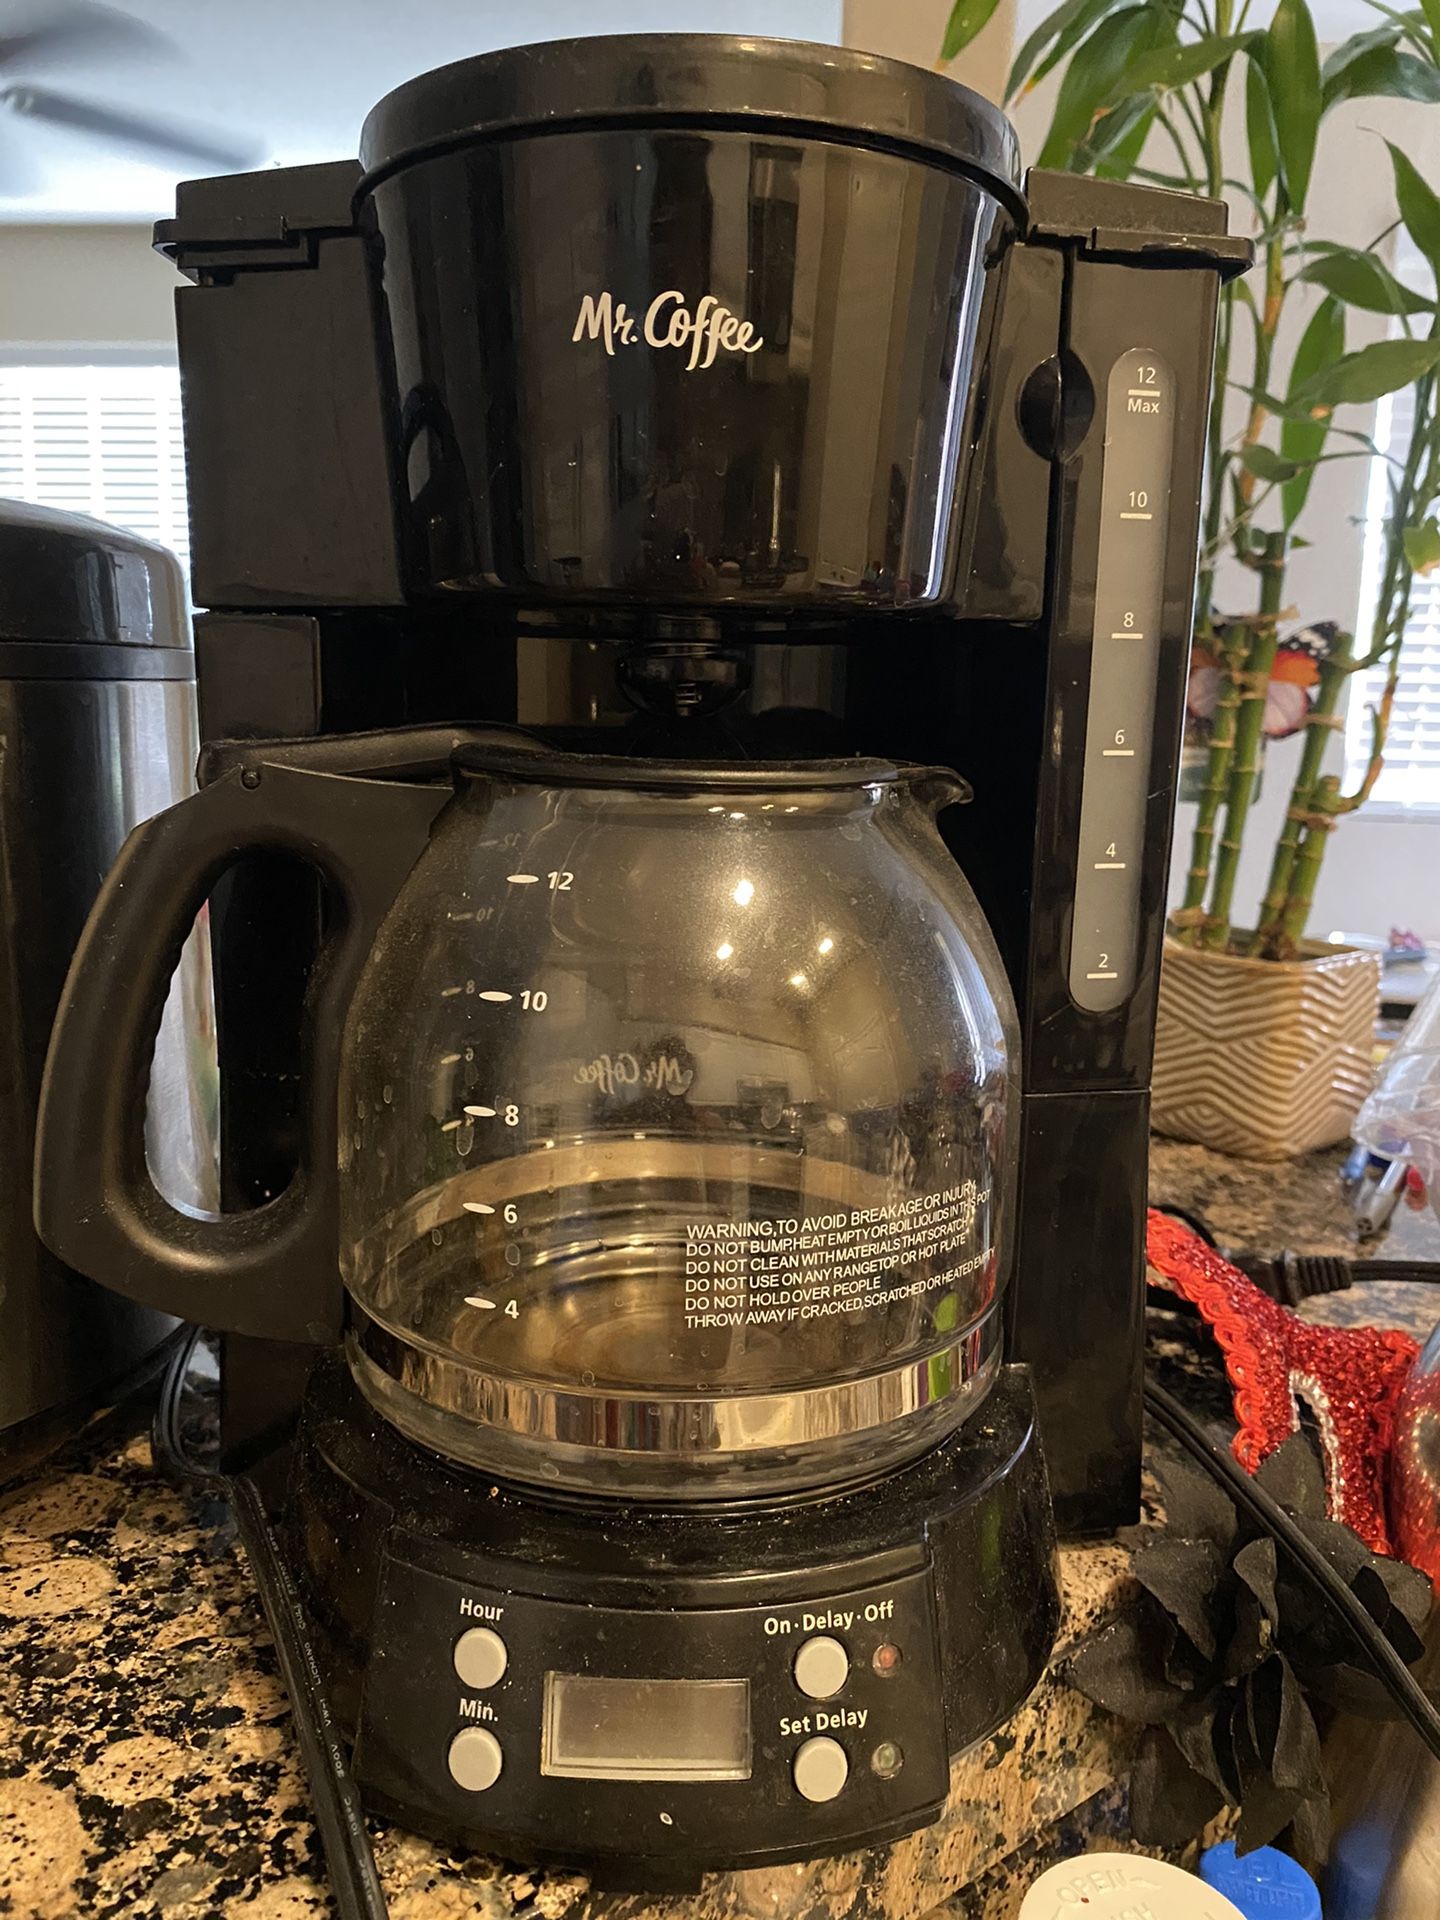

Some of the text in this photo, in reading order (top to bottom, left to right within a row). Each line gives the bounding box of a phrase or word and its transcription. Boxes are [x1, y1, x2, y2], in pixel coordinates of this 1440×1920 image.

[572, 290, 764, 371] Mr. Coffee
[1136, 367, 1156, 385] 12
[1127, 398, 1160, 414] Max
[1129, 491, 1148, 508] 10
[1123, 612, 1134, 628] 8
[1114, 729, 1125, 745] 6
[1105, 842, 1116, 857] 4
[547, 871, 574, 891] 12
[1098, 953, 1109, 968] 2
[520, 990, 548, 1012] 10
[505, 1104, 519, 1127] 8
[504, 1204, 518, 1224] 6
[686, 1243, 711, 1256] DO
[714, 1242, 747, 1255] NOT
[828, 1227, 872, 1246] EMPTY
[871, 1224, 888, 1239] OR
[889, 1219, 912, 1235] BOIL
[914, 1207, 949, 1229] LIQUIDS
[976, 1189, 991, 1206] POT
[801, 1213, 847, 1233] AVOID
[851, 1198, 922, 1226] BREAKAGE
[923, 1193, 941, 1210] OR
[685, 1232, 966, 1292] DO NOT USE ON ANY RANGETOP OR HOT PLATE
[686, 1261, 711, 1275] DO
[713, 1259, 747, 1273] NOT
[750, 1255, 798, 1271] CLEAN
[801, 1250, 835, 1266] WITH
[836, 1238, 900, 1262] MATERIALS
[901, 1232, 928, 1248] THAT
[685, 1276, 881, 1311] DO NOT HOLD OVER PEOPLE
[685, 1312, 743, 1329] THROW
[746, 1309, 786, 1325] AWAY
[787, 1307, 800, 1321] IF
[927, 1275, 941, 1290] OR
[942, 1262, 973, 1283] HEATED
[505, 1299, 520, 1319] 4
[460, 1598, 504, 1622] Hour
[764, 1601, 894, 1636] On Delay Off
[459, 1698, 499, 1722] Min.
[780, 1708, 868, 1737] Set Delay
[1056, 1868, 1128, 1904] OPEN
